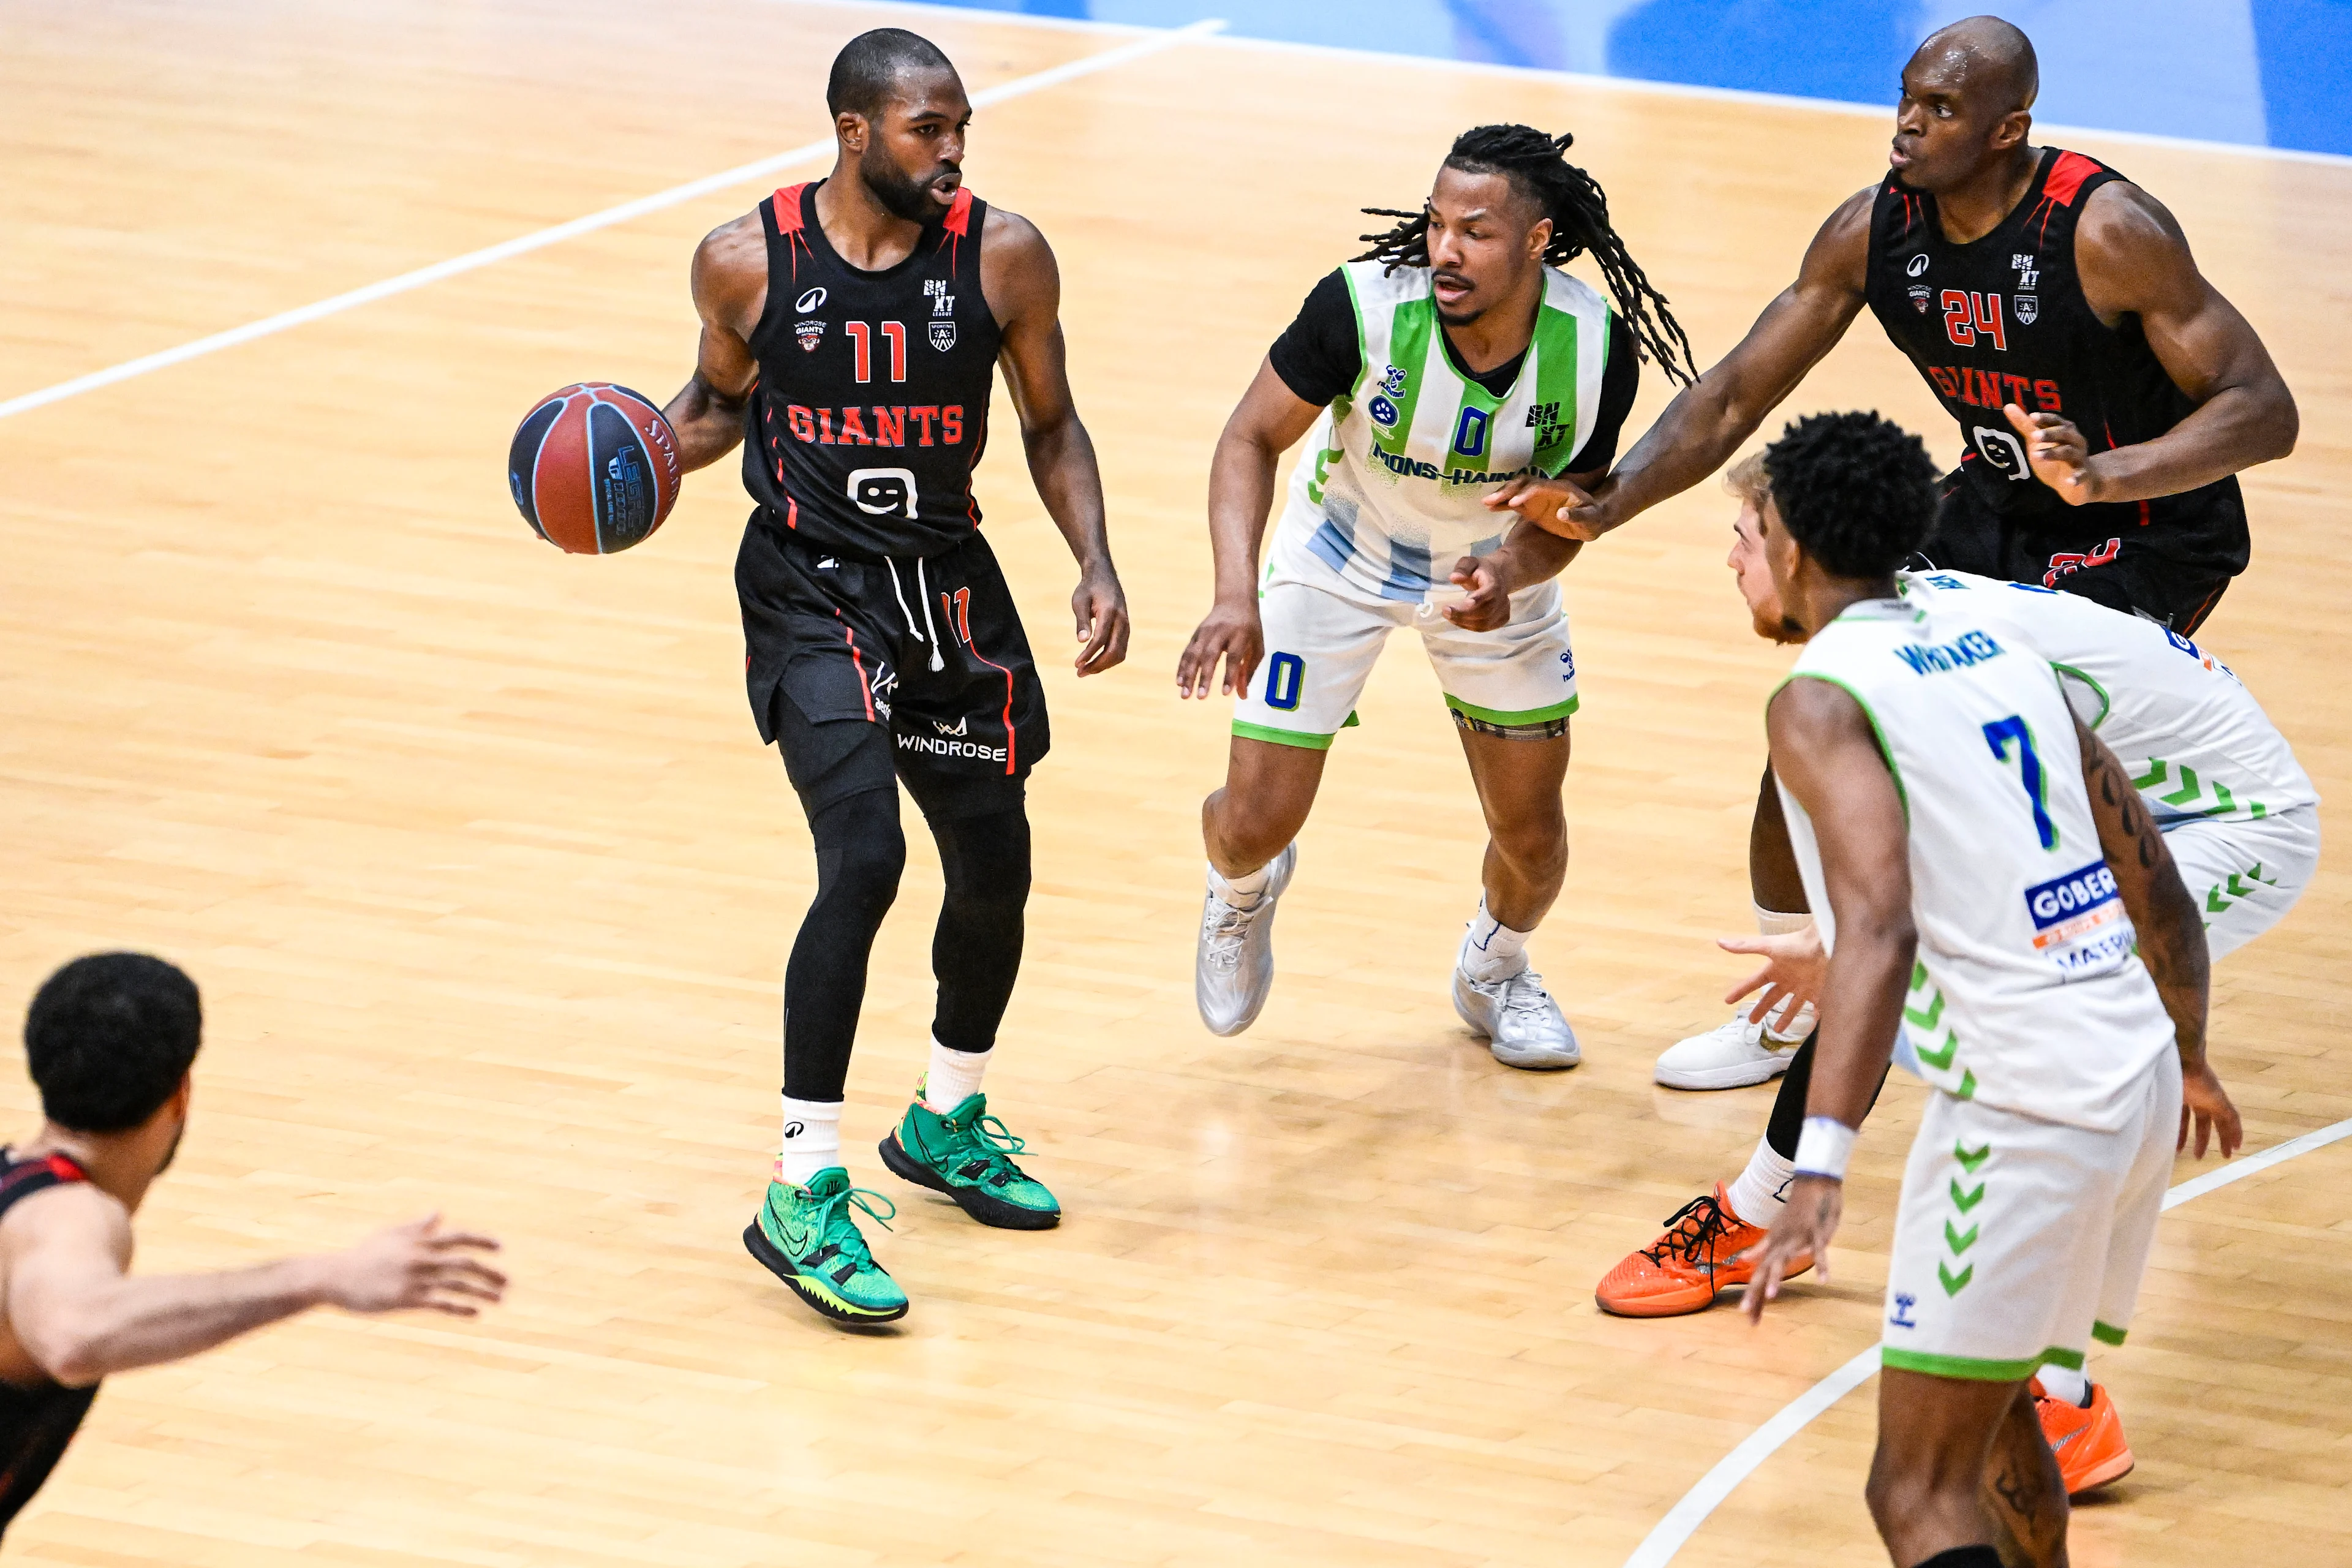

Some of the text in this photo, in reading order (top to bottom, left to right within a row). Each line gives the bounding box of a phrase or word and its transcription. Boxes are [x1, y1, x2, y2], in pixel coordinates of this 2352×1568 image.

[1909, 290, 1931, 298] GIANTS
[794, 320, 827, 328] WINDROSE
[796, 326, 824, 335] GIANTS
[1940, 288, 2007, 350] 24
[845, 321, 907, 383] 11
[786, 404, 964, 447] GIANTS
[1453, 405, 1490, 457] 0
[1265, 651, 1306, 712] 0
[897, 733, 1008, 762] WINDROSE
[1983, 714, 2060, 851] 7
